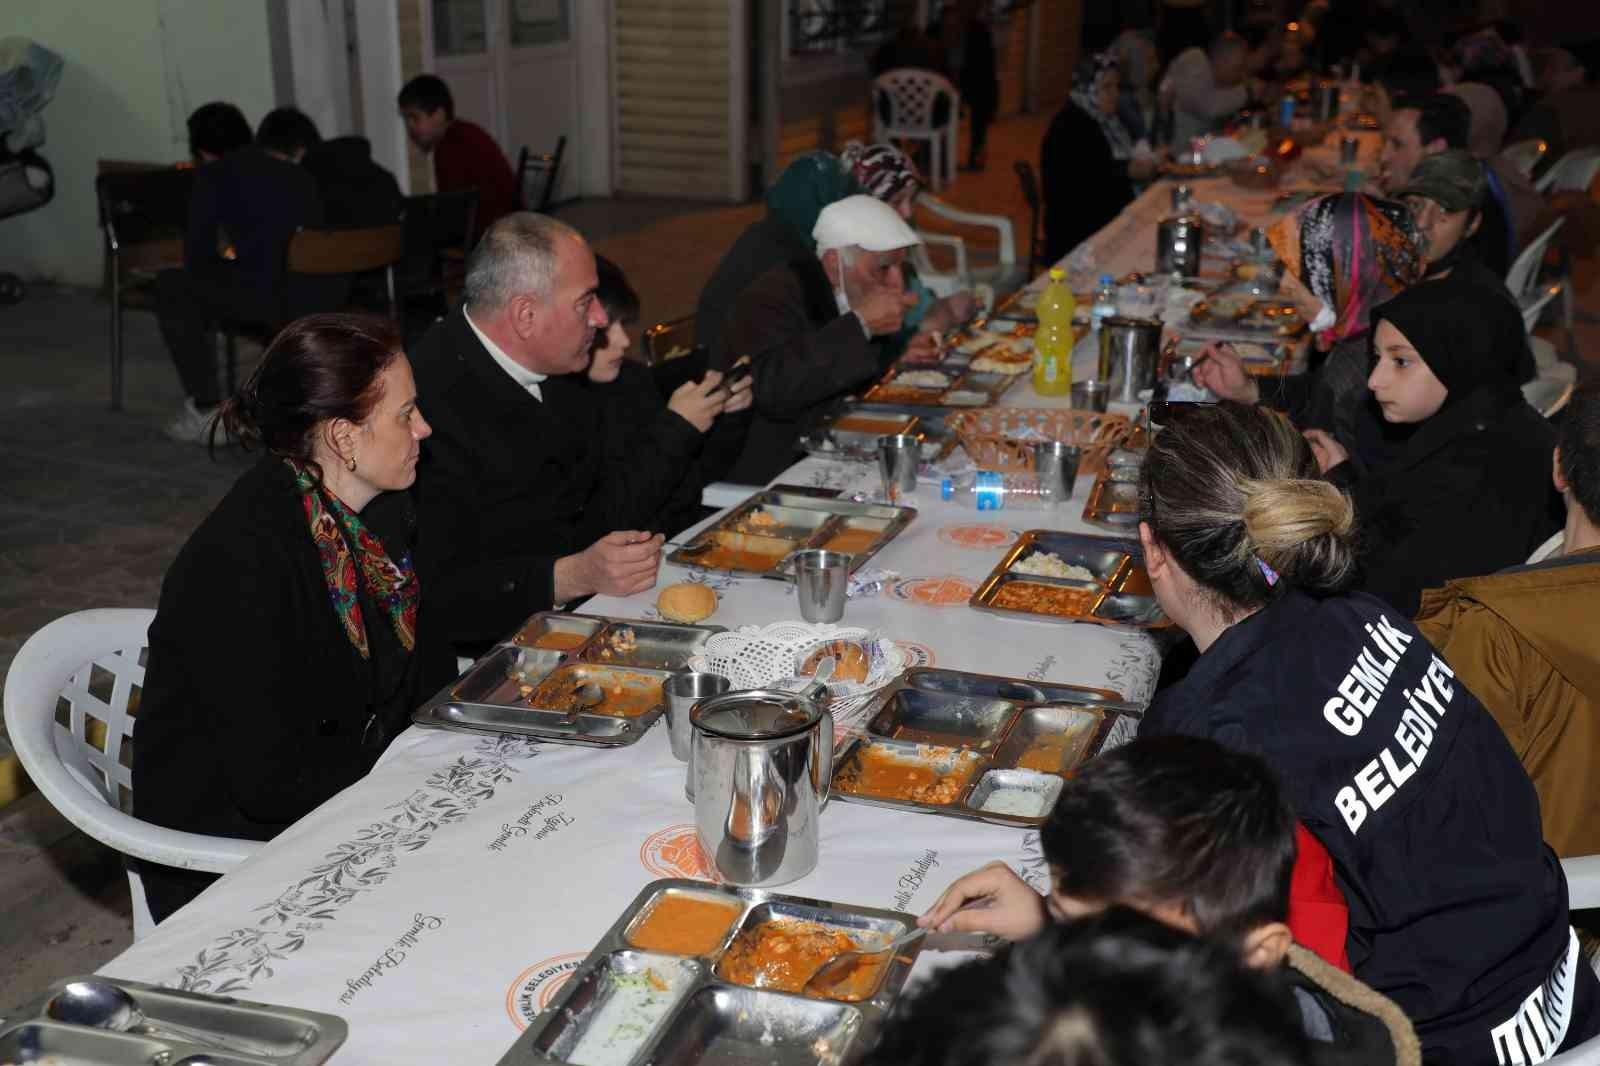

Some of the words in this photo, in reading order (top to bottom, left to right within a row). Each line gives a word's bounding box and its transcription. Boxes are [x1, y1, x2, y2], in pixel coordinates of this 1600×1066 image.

[1323, 614, 1413, 736] GEMLİK
[394, 912, 442, 948] Gemlik
[339, 948, 406, 1006] Belediyesi
